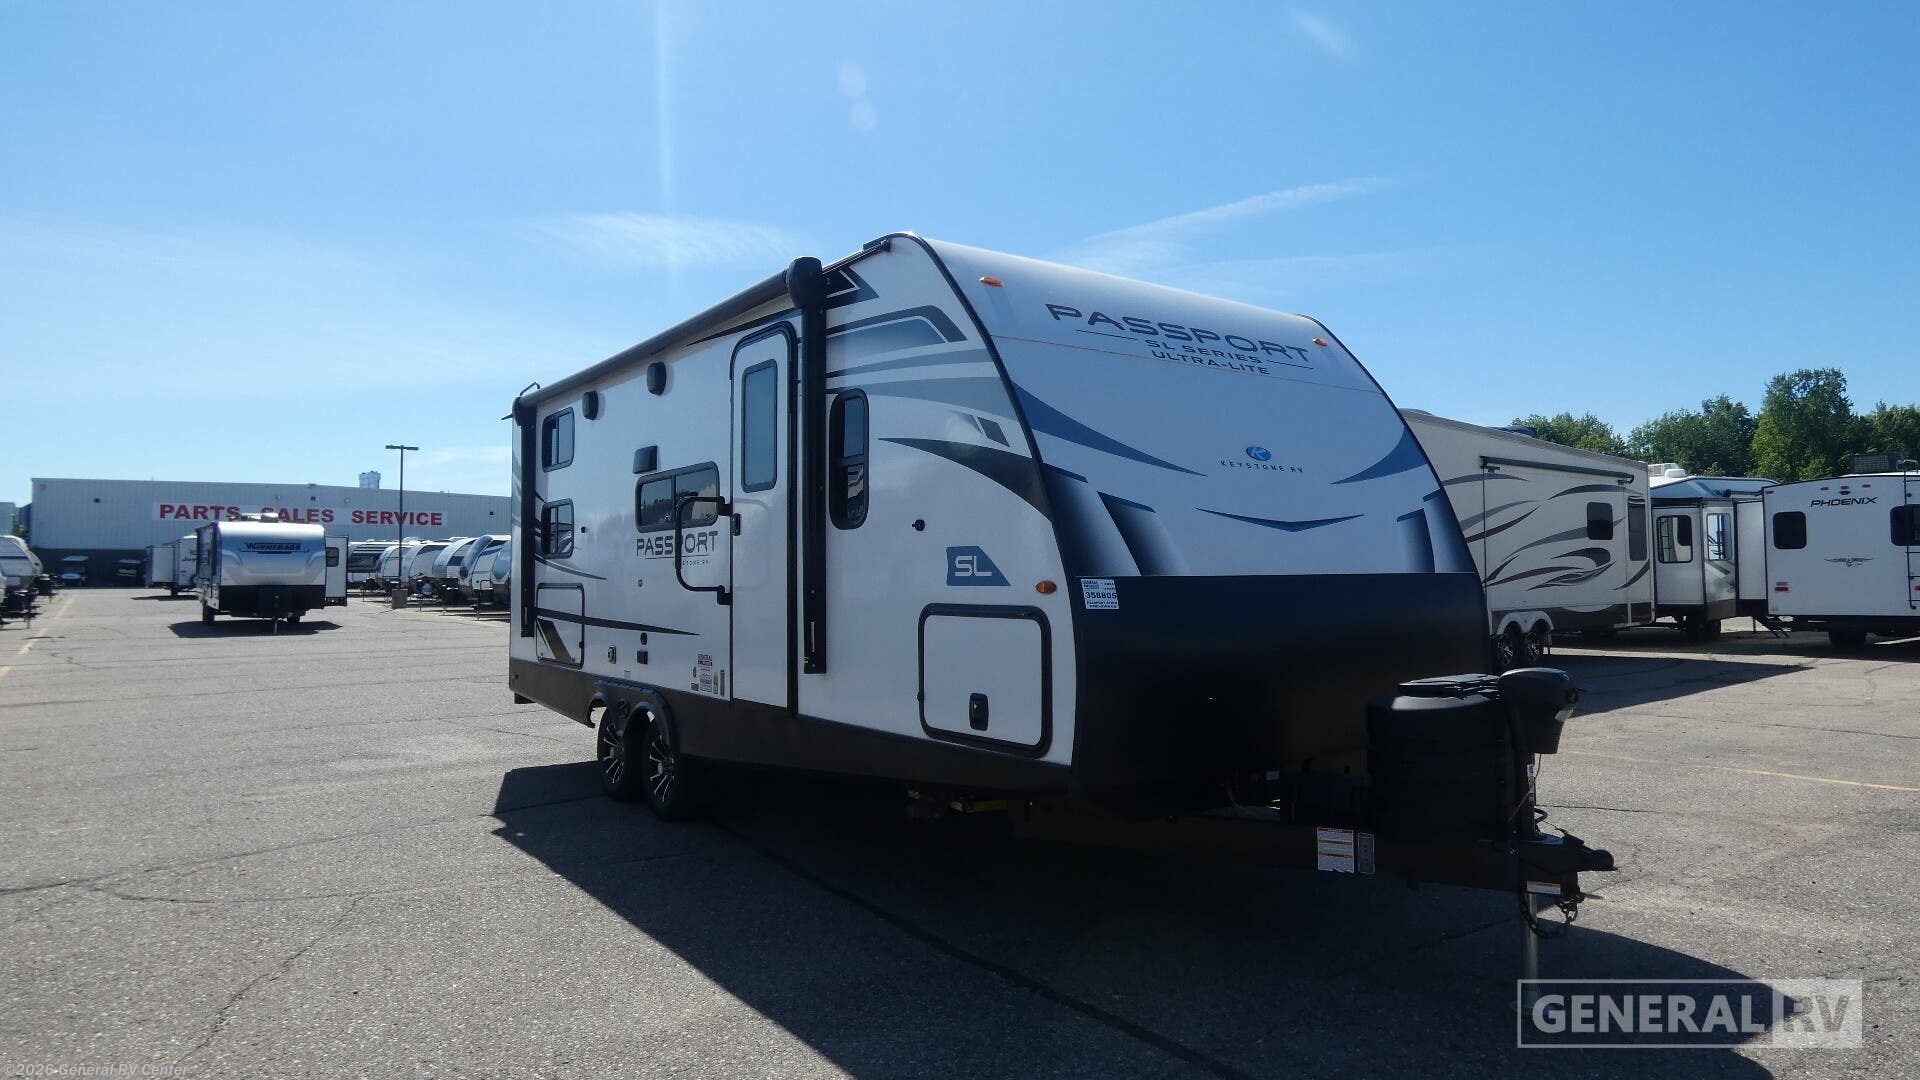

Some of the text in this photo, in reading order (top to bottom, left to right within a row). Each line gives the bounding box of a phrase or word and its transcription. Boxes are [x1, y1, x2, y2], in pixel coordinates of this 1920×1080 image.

[1045, 303, 1309, 362] PASSPORT
[1144, 339, 1263, 364] SL SERIES
[1151, 350, 1271, 375] ULTRA-LITE
[1220, 460, 1285, 472] KEYSTONE
[1810, 496, 1879, 508] PHOENIX
[159, 504, 241, 521] PARTS
[351, 509, 443, 526] SERVICE
[636, 530, 719, 557] PASSORT
[954, 555, 993, 577] SL
